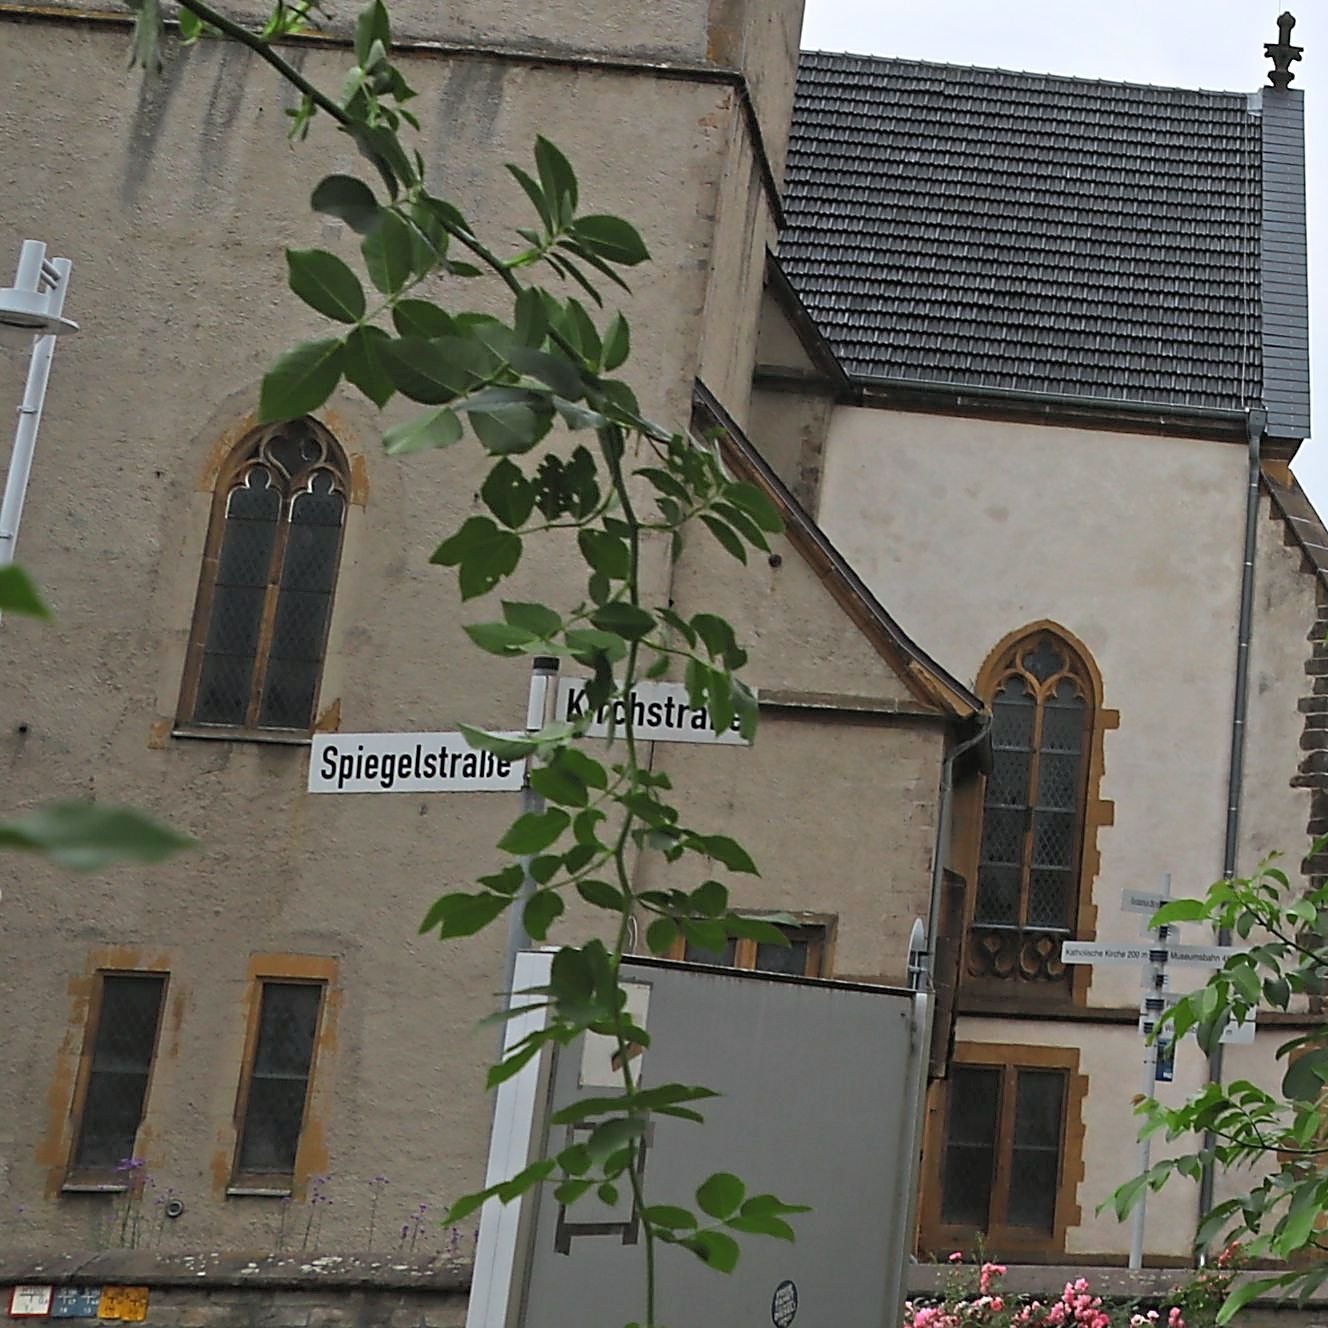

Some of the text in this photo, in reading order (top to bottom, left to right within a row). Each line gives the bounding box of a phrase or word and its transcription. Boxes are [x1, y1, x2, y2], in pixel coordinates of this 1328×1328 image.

[566, 688, 743, 731] Krchstrae
[321, 744, 511, 788] Spiegelstraße
[1105, 950, 1126, 959] Kirche
